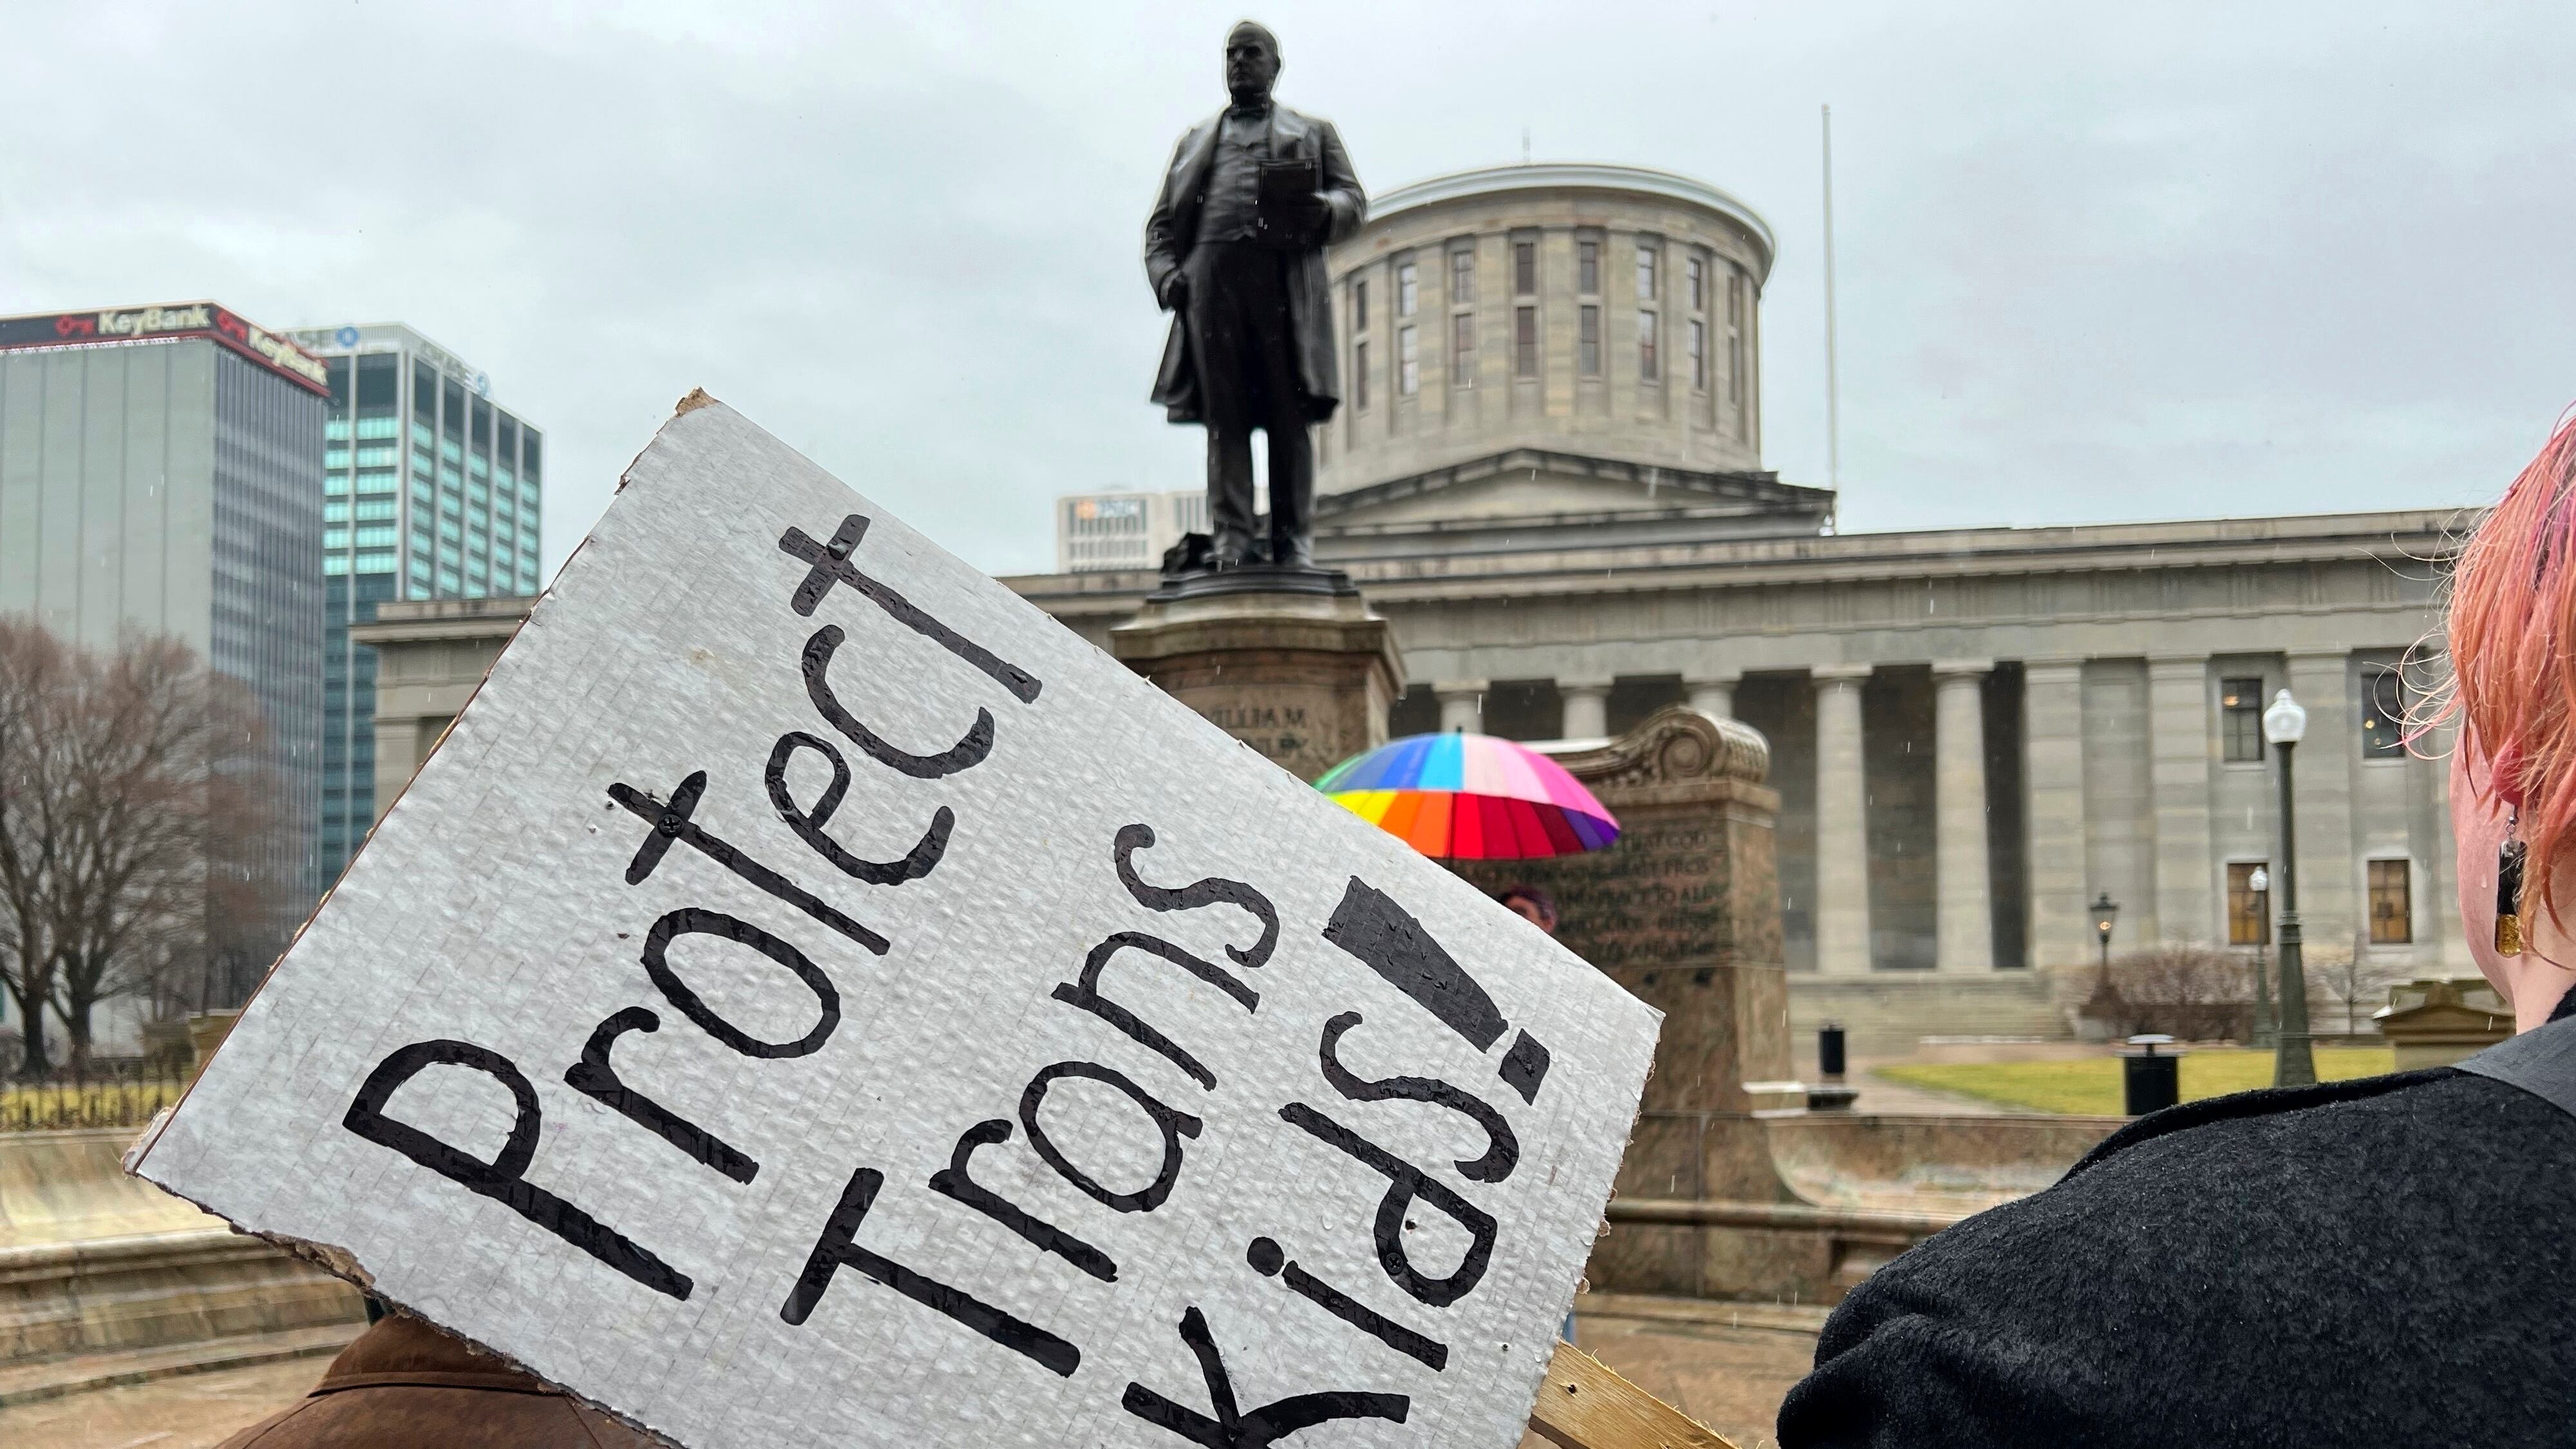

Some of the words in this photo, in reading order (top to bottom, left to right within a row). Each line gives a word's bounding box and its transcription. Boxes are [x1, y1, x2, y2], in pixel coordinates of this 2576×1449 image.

[98, 305, 211, 337] KeyBank
[249, 327, 328, 386] KeyBank
[341, 513, 1043, 1302] Protect
[779, 823, 1280, 1378] Trans
[1121, 875, 1551, 1448] Kids!
